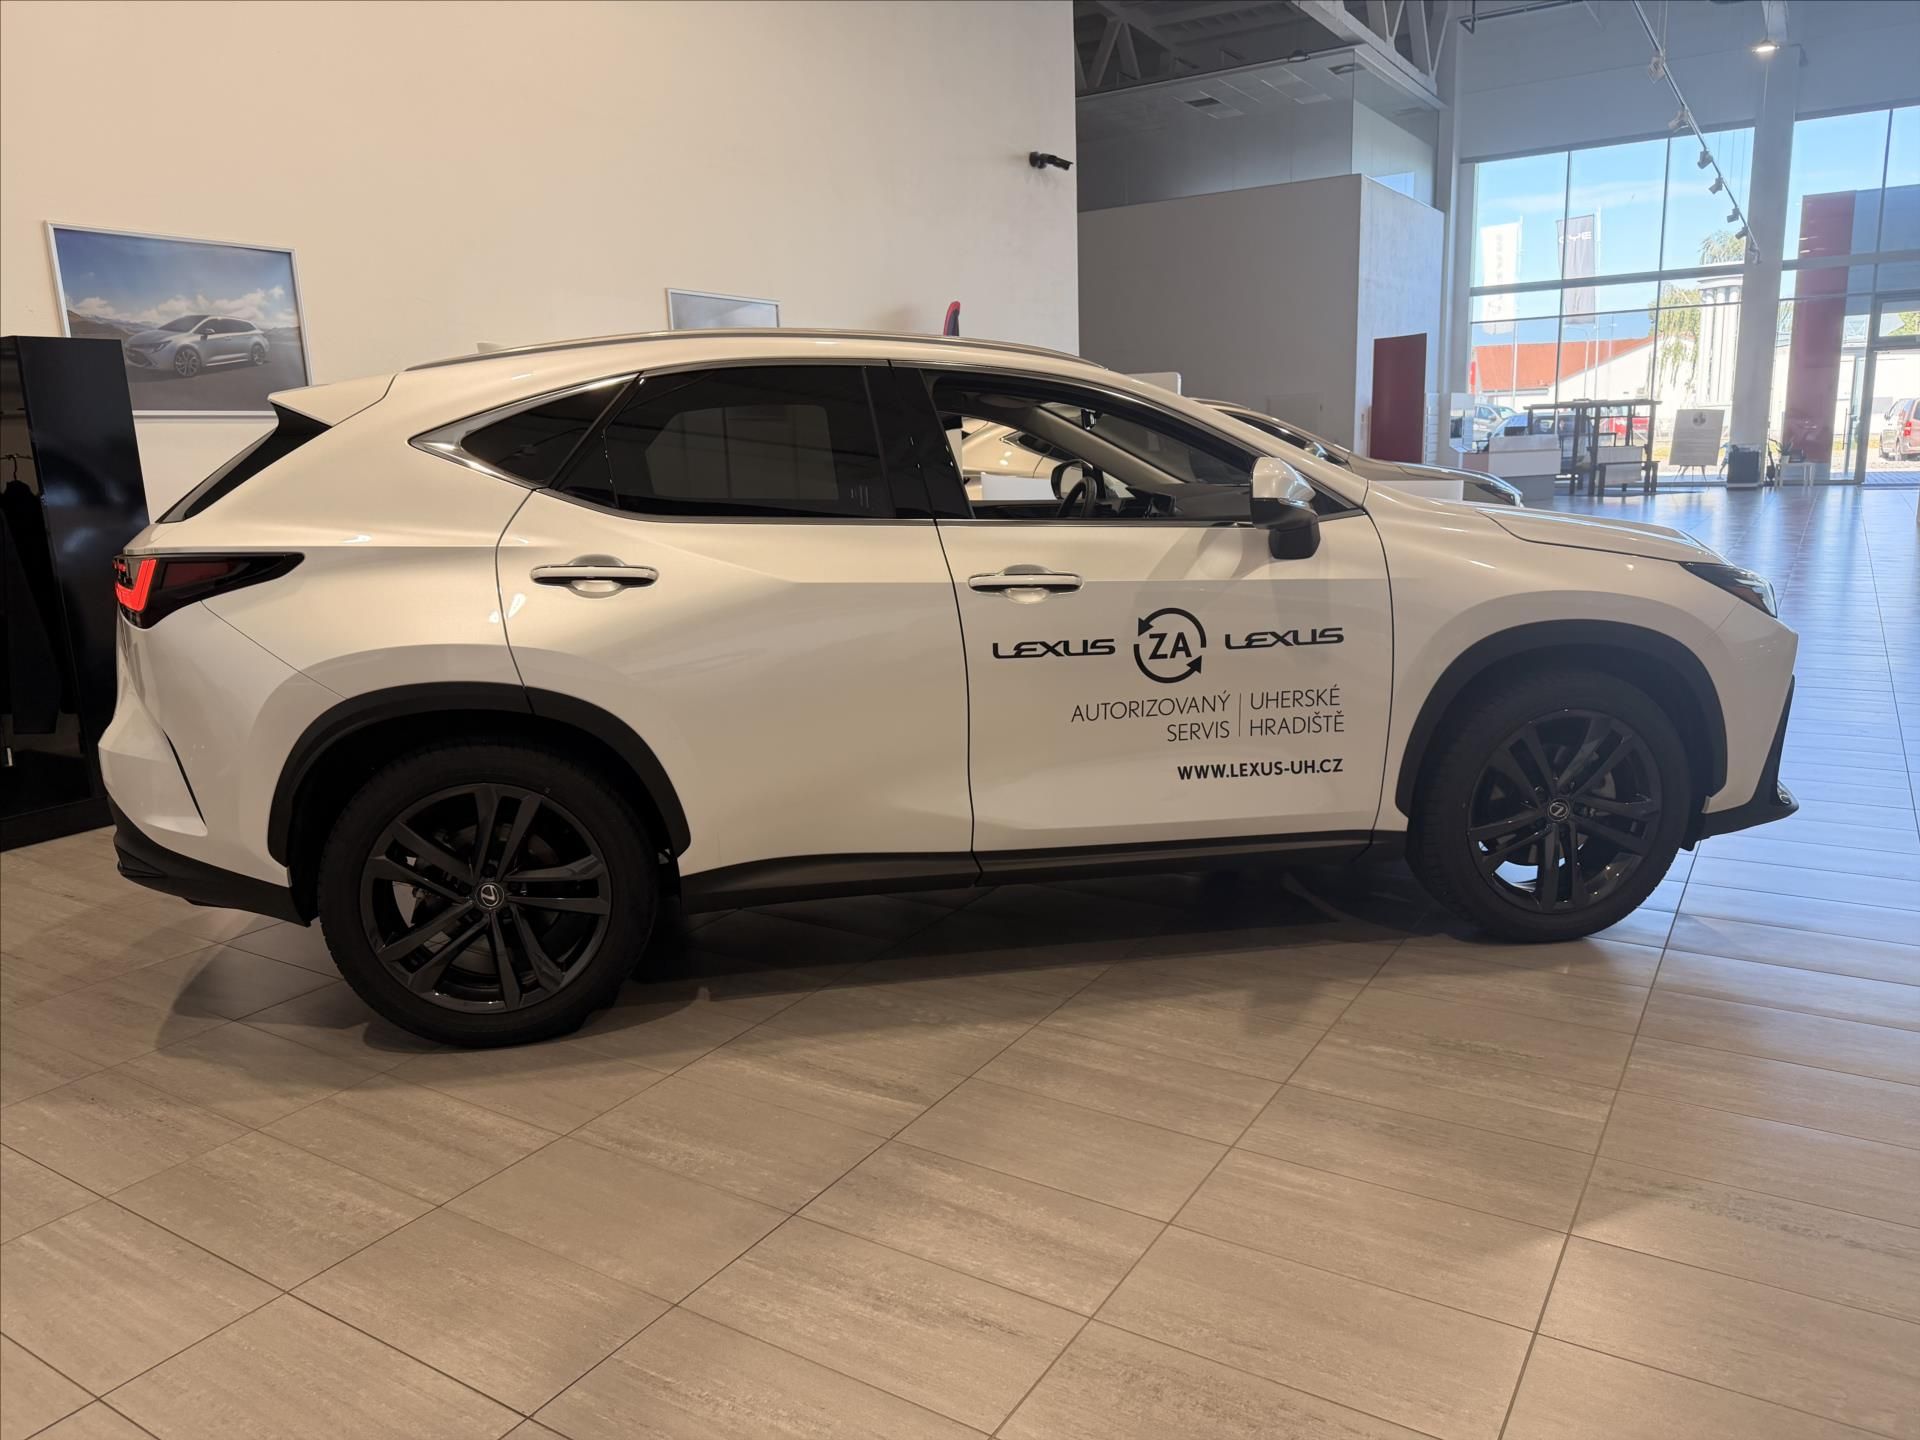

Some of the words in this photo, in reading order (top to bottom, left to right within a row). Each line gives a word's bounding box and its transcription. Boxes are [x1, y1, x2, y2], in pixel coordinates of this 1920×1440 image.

[992, 638, 1116, 660] LEXUS
[1148, 631, 1192, 660] ZA
[1224, 626, 1345, 650] LEXUS
[1071, 689, 1231, 723] AUTORIZOVANÝ
[1250, 683, 1341, 710] UHERSKÉ
[1166, 720, 1231, 742] SERVIS
[1249, 709, 1345, 737] HRADIŠTĚ
[1177, 757, 1344, 781] WWW.LEXUS-UH.CZ
